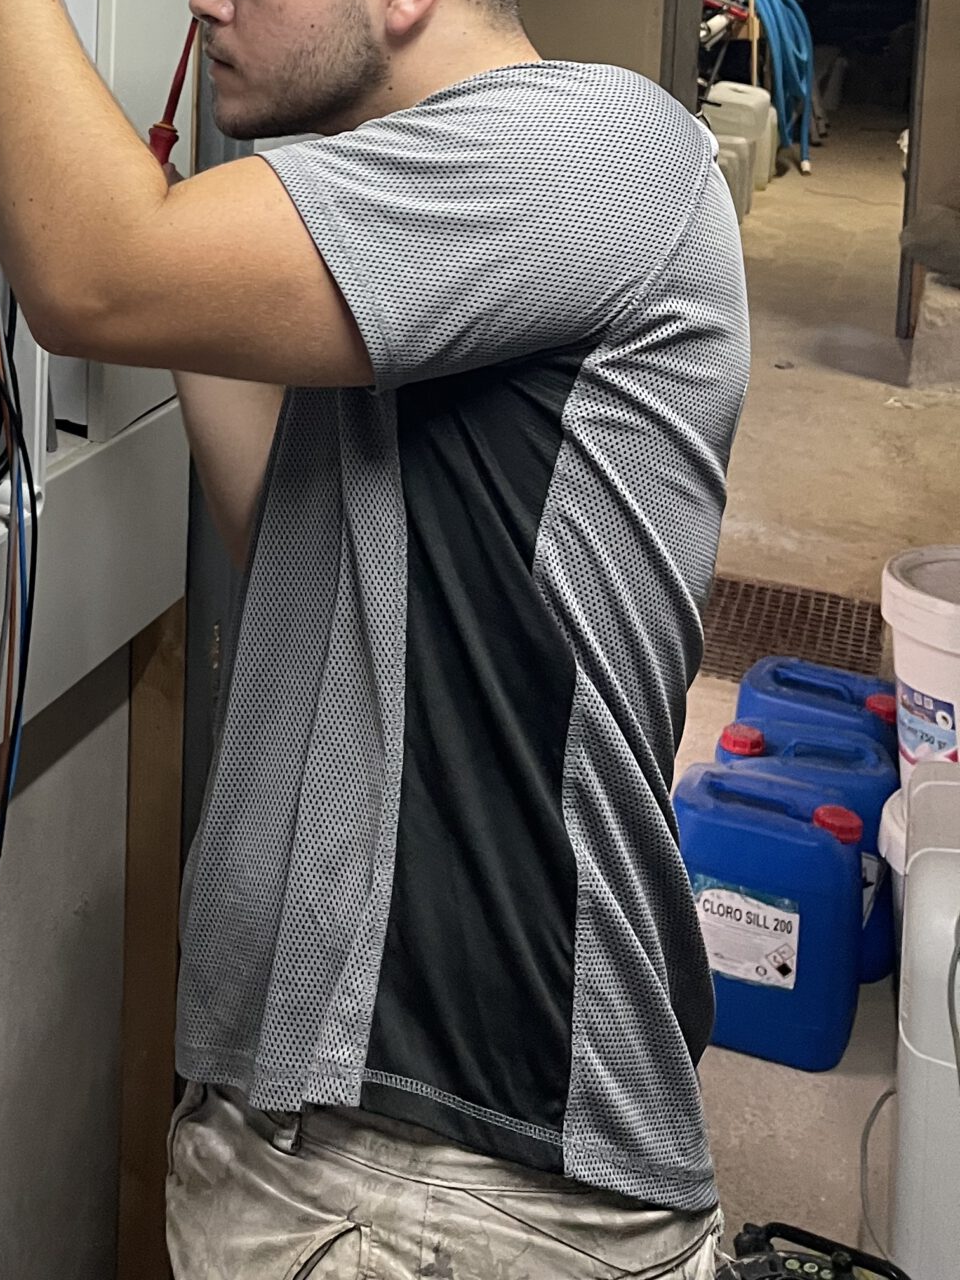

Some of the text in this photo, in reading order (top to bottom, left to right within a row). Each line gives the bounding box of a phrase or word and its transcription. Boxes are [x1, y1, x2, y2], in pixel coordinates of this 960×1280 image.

[702, 898, 793, 935] CLORO SILL 200
